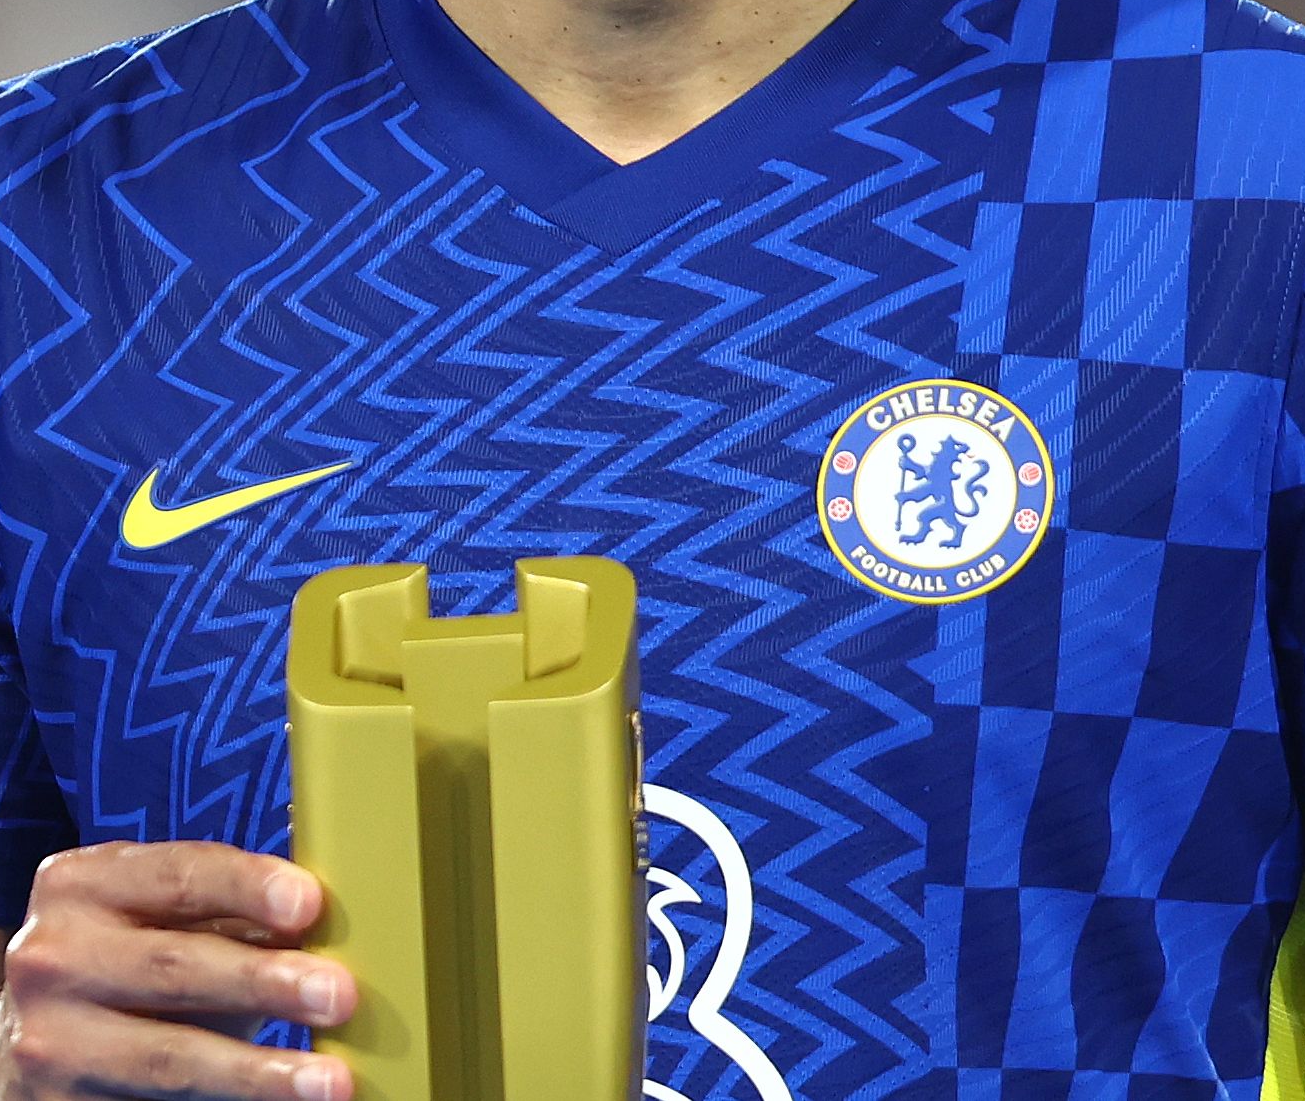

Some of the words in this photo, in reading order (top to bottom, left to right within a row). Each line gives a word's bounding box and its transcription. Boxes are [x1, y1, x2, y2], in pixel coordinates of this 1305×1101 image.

[866, 388, 1016, 443] CHELSEA
[851, 545, 947, 592] FOOTBALL
[956, 553, 1006, 587] CLUB
